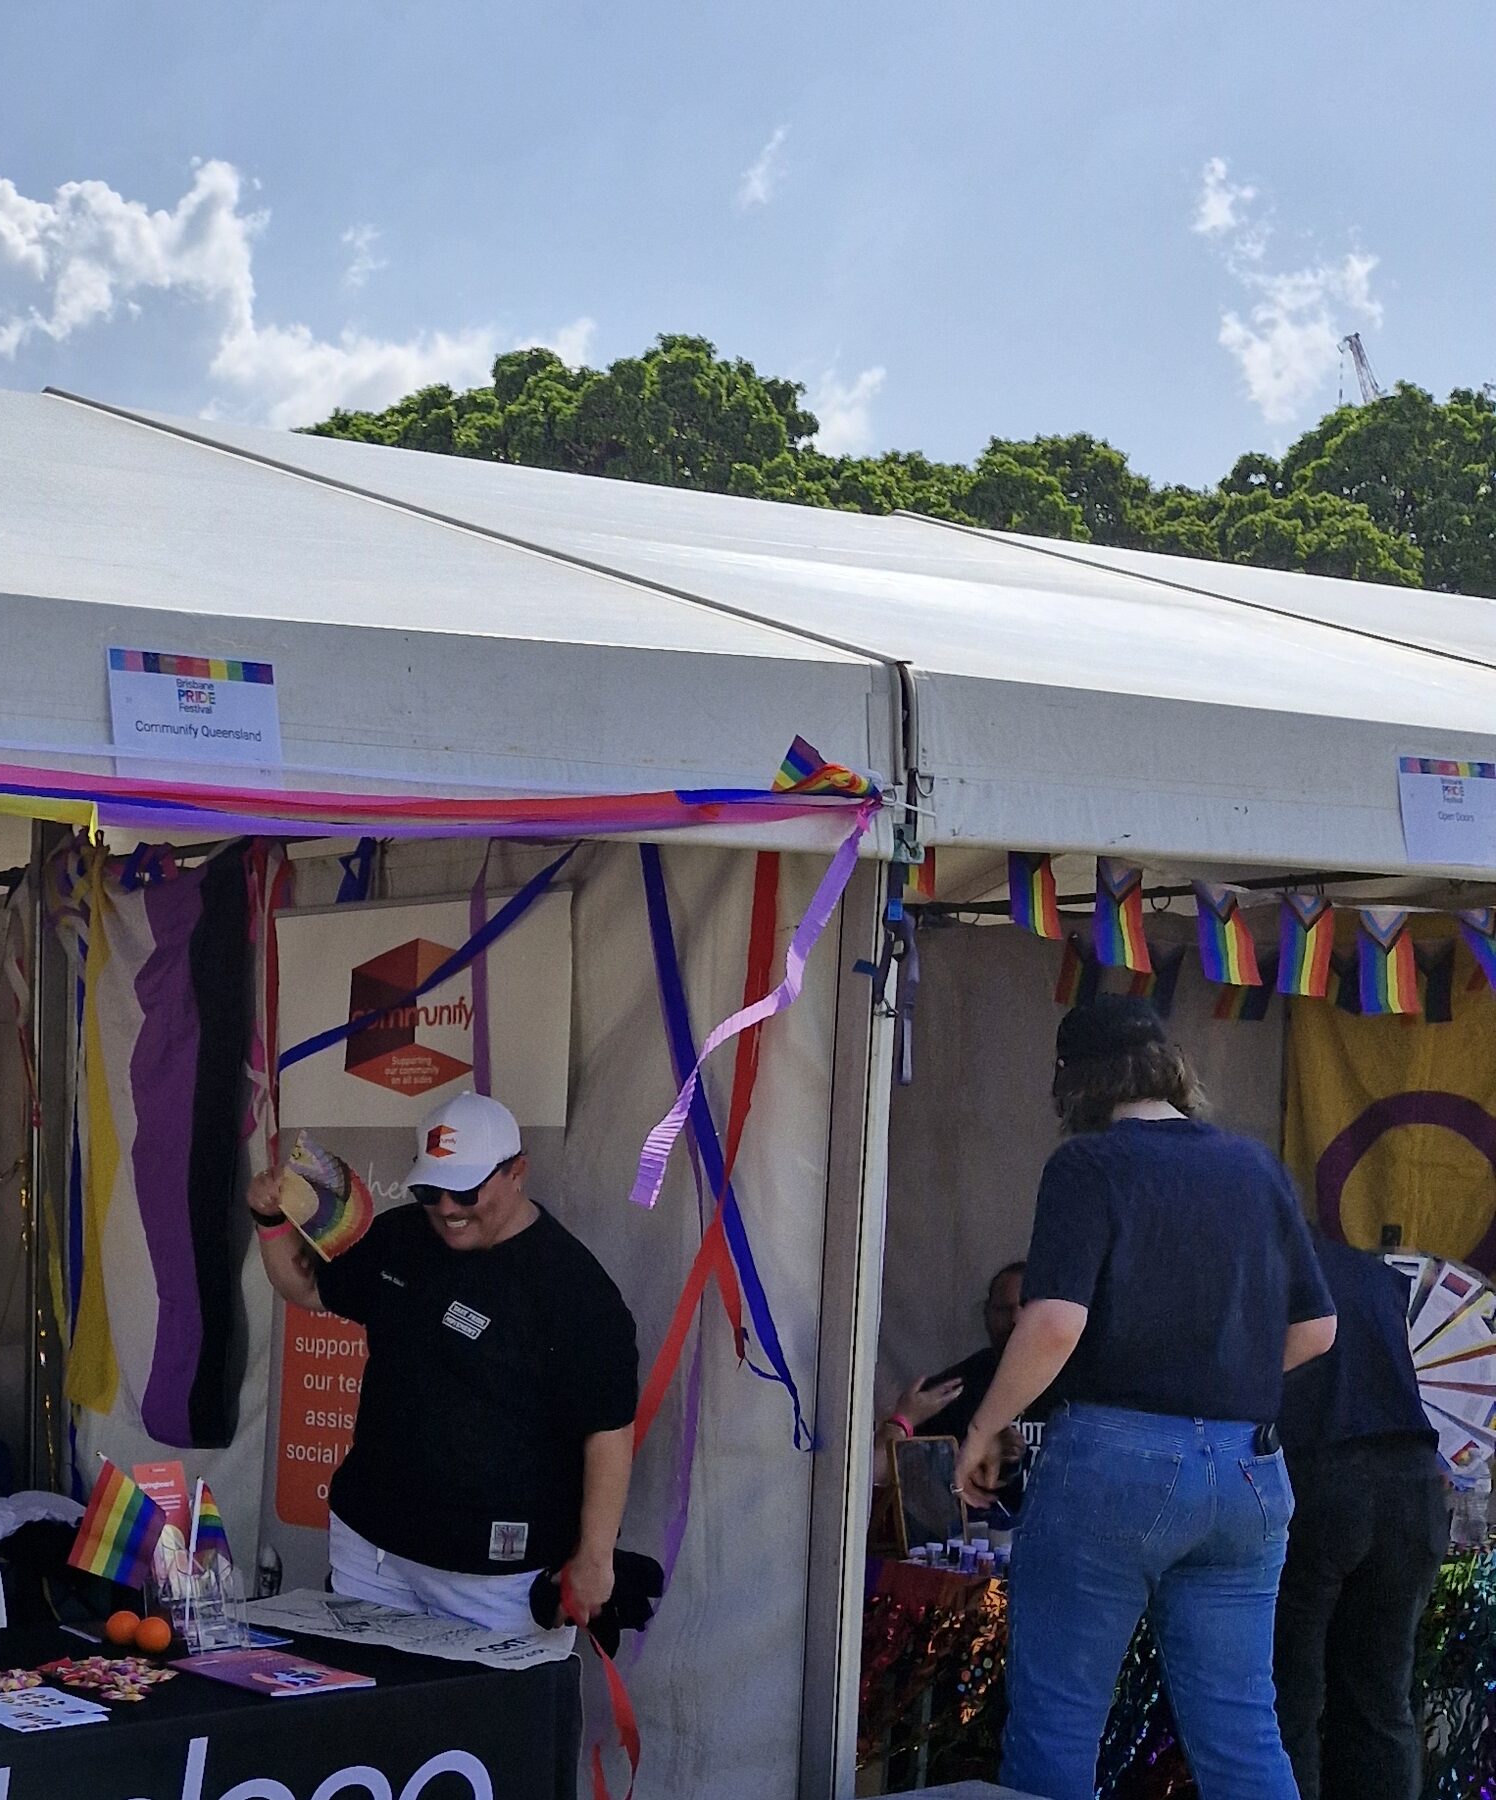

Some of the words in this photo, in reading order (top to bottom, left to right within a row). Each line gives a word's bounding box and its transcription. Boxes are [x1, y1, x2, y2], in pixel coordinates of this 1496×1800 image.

[176, 679, 214, 690] Brisbane
[178, 689, 215, 704] PRIDE
[179, 703, 212, 714] Festival
[135, 720, 199, 738] Communify
[201, 726, 262, 742] Queensland
[295, 1335, 365, 1360] support
[303, 1374, 333, 1392] our
[305, 1408, 357, 1430] assis
[286, 1443, 338, 1465] social
